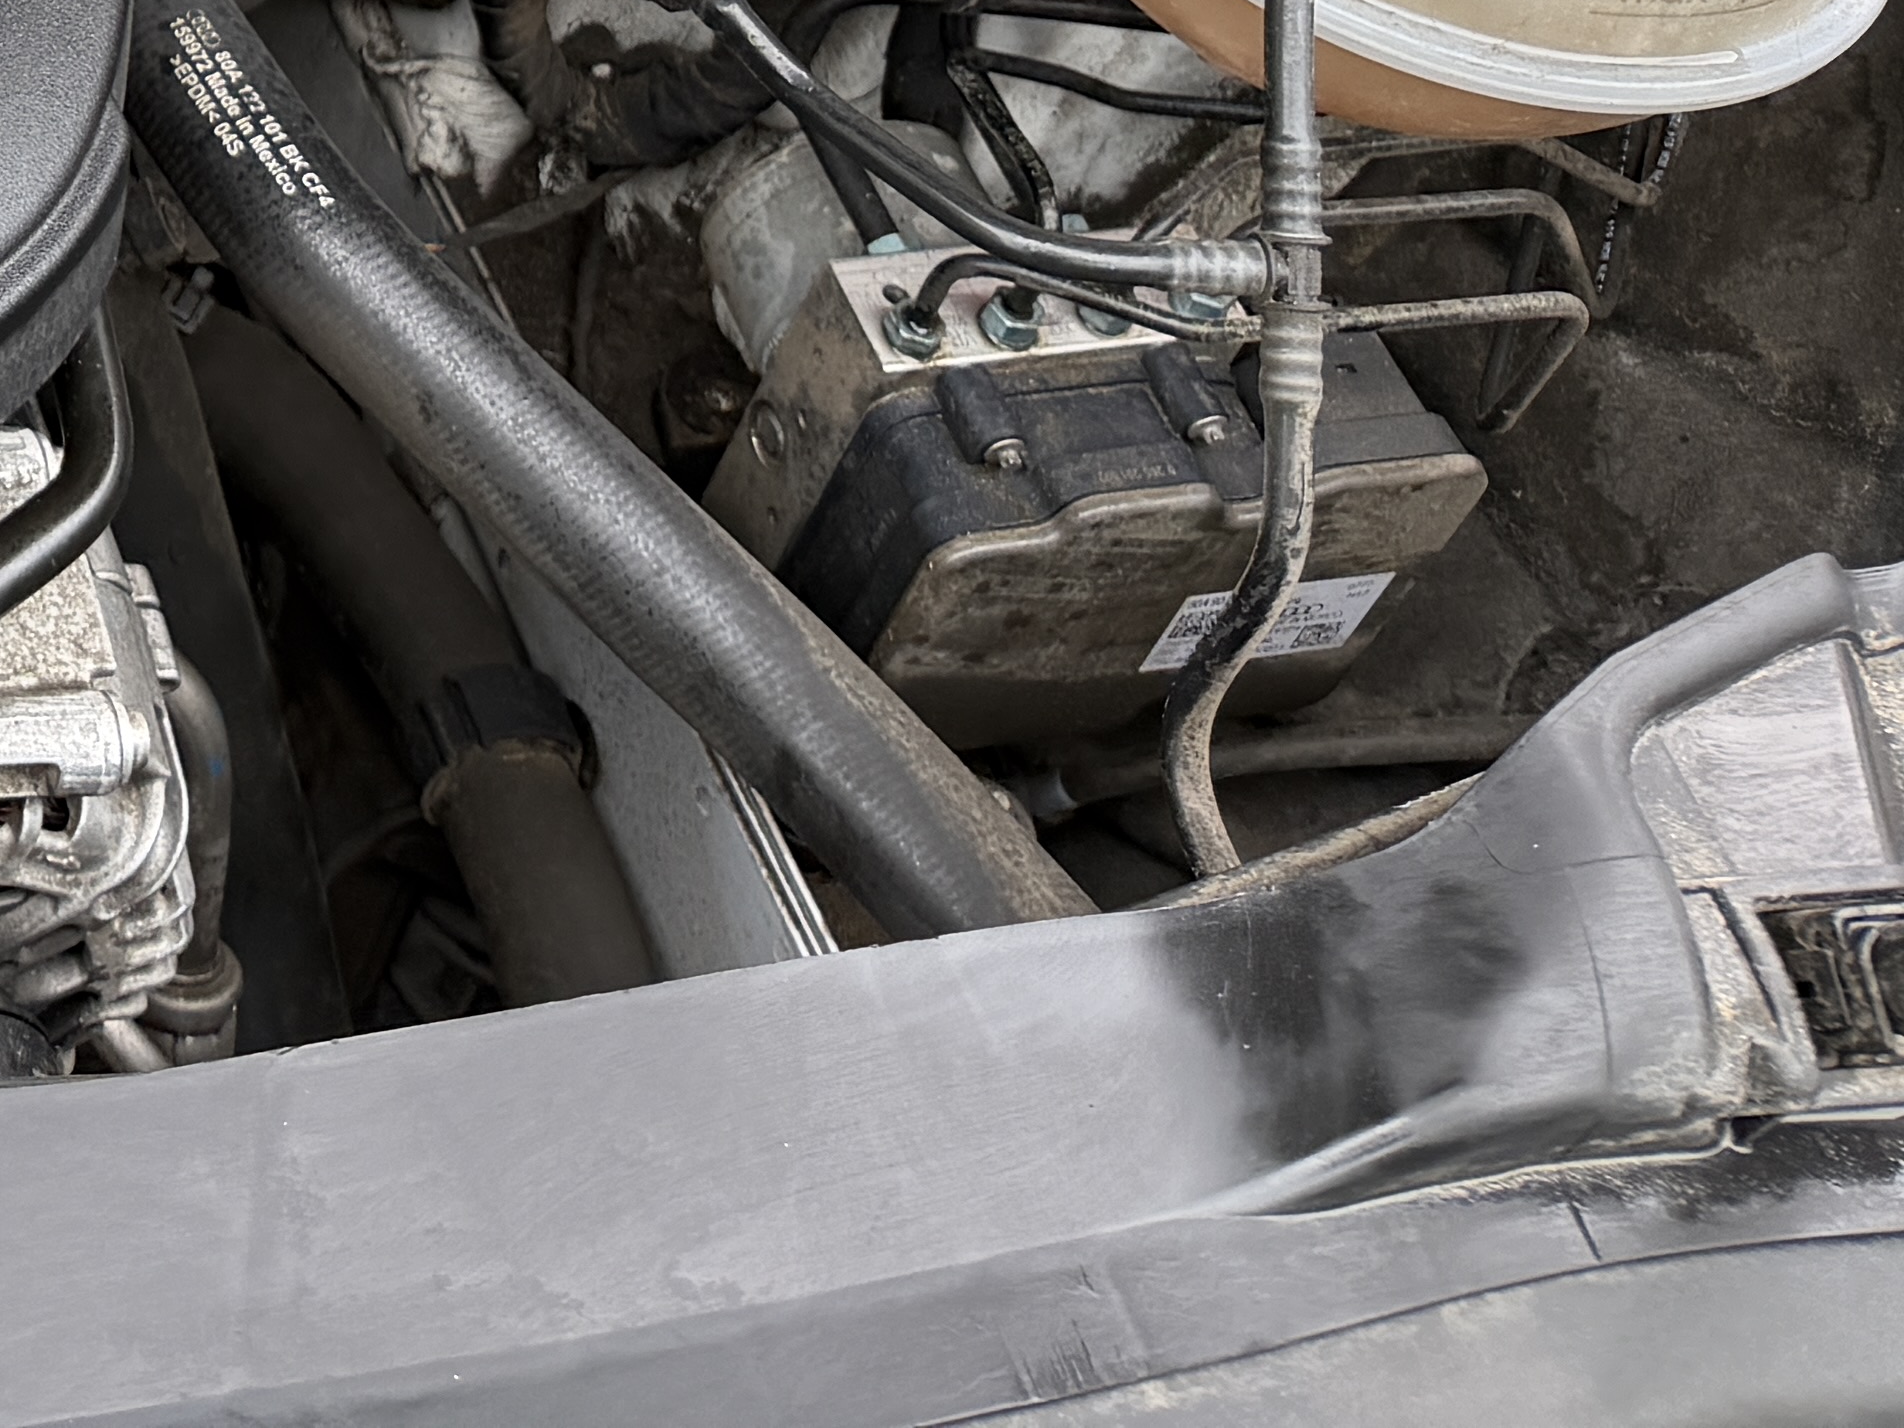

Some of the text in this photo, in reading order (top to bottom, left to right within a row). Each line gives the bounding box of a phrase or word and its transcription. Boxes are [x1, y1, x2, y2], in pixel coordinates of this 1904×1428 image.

[170, 17, 214, 73] 159972
[206, 72, 242, 117] Made
[249, 135, 297, 195] Mexico
[214, 122, 245, 157] 04S
[215, 51, 243, 83] 80A
[260, 115, 288, 143] 101
[280, 144, 310, 171] BK
